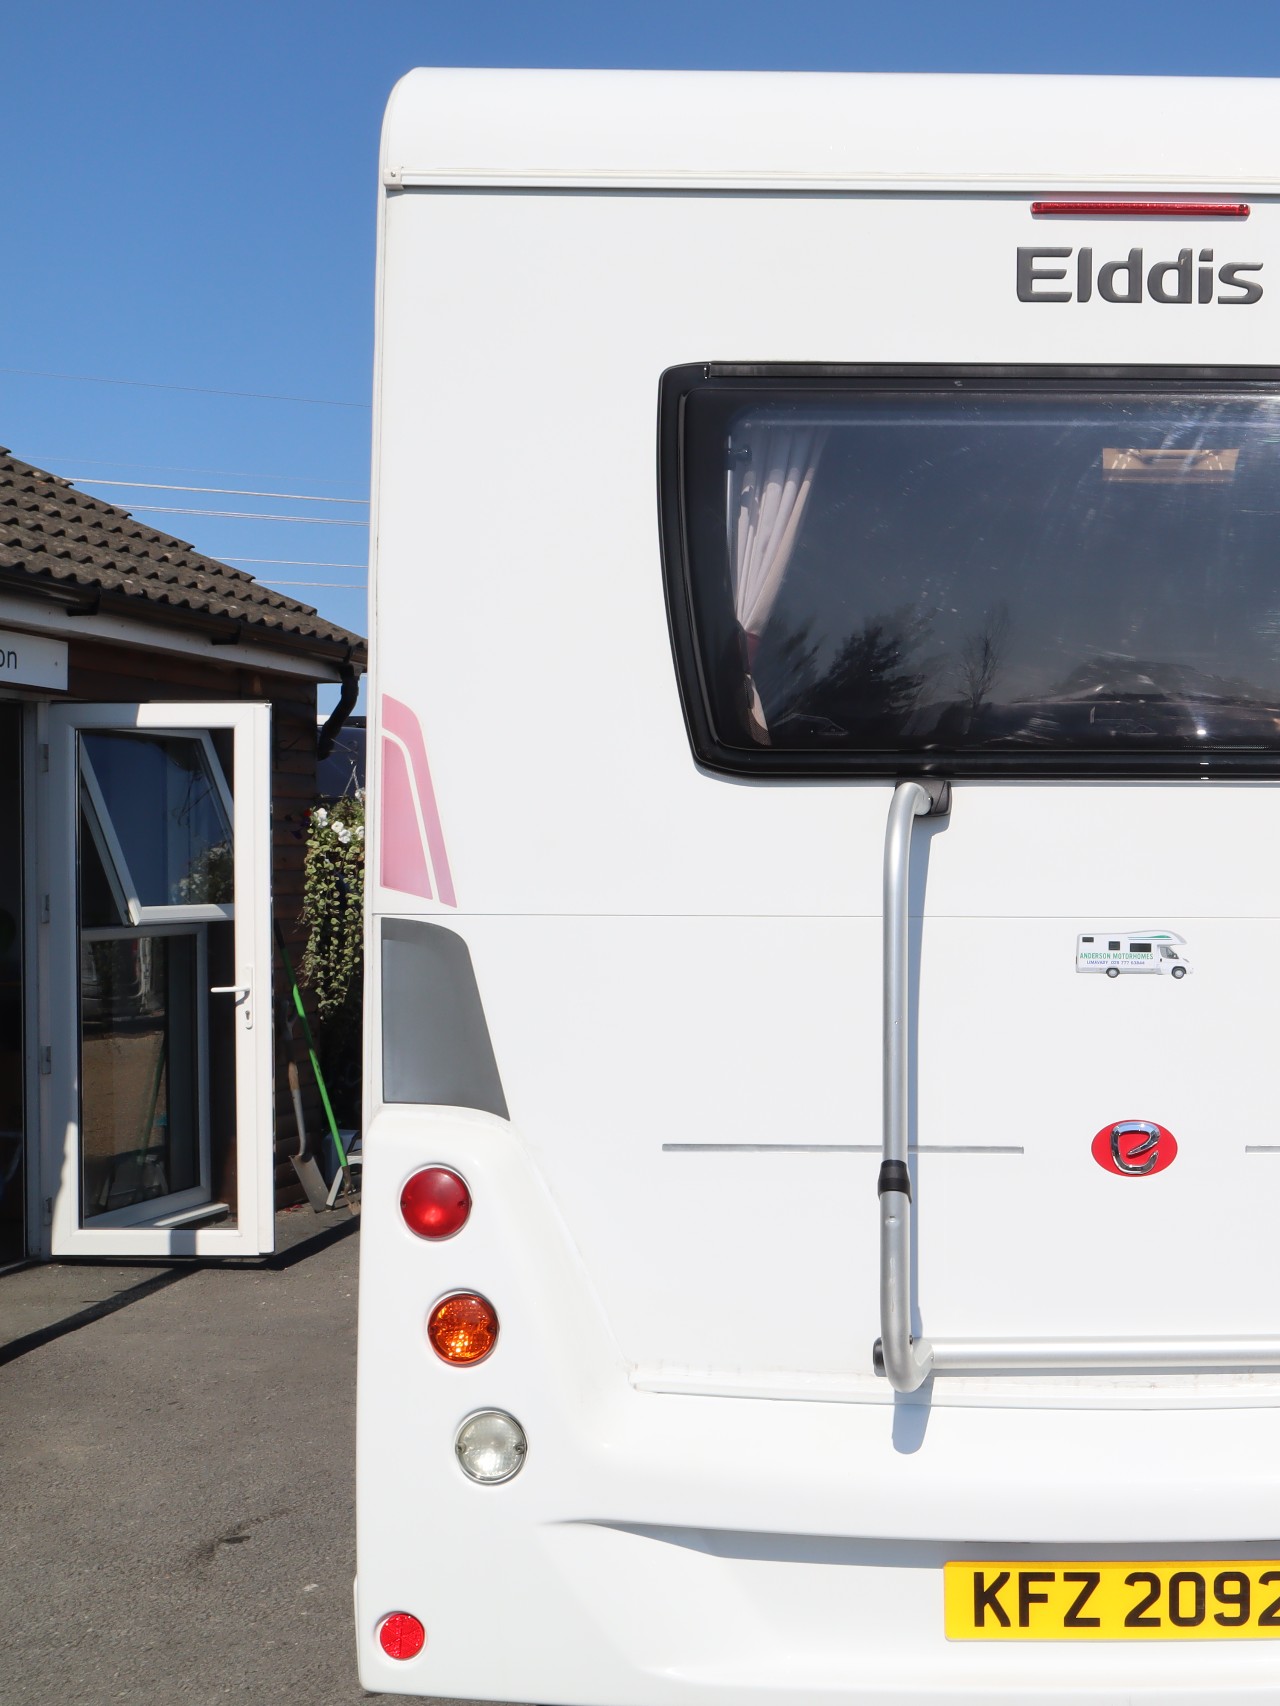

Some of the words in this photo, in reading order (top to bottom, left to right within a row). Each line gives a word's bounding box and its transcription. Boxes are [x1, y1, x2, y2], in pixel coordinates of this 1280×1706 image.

[1016, 246, 1264, 305] Elddis
[1080, 952, 1111, 960] ANDERSON
[1112, 952, 1154, 960] MOTORHOMES
[973, 1571, 1101, 1628] KFZ
